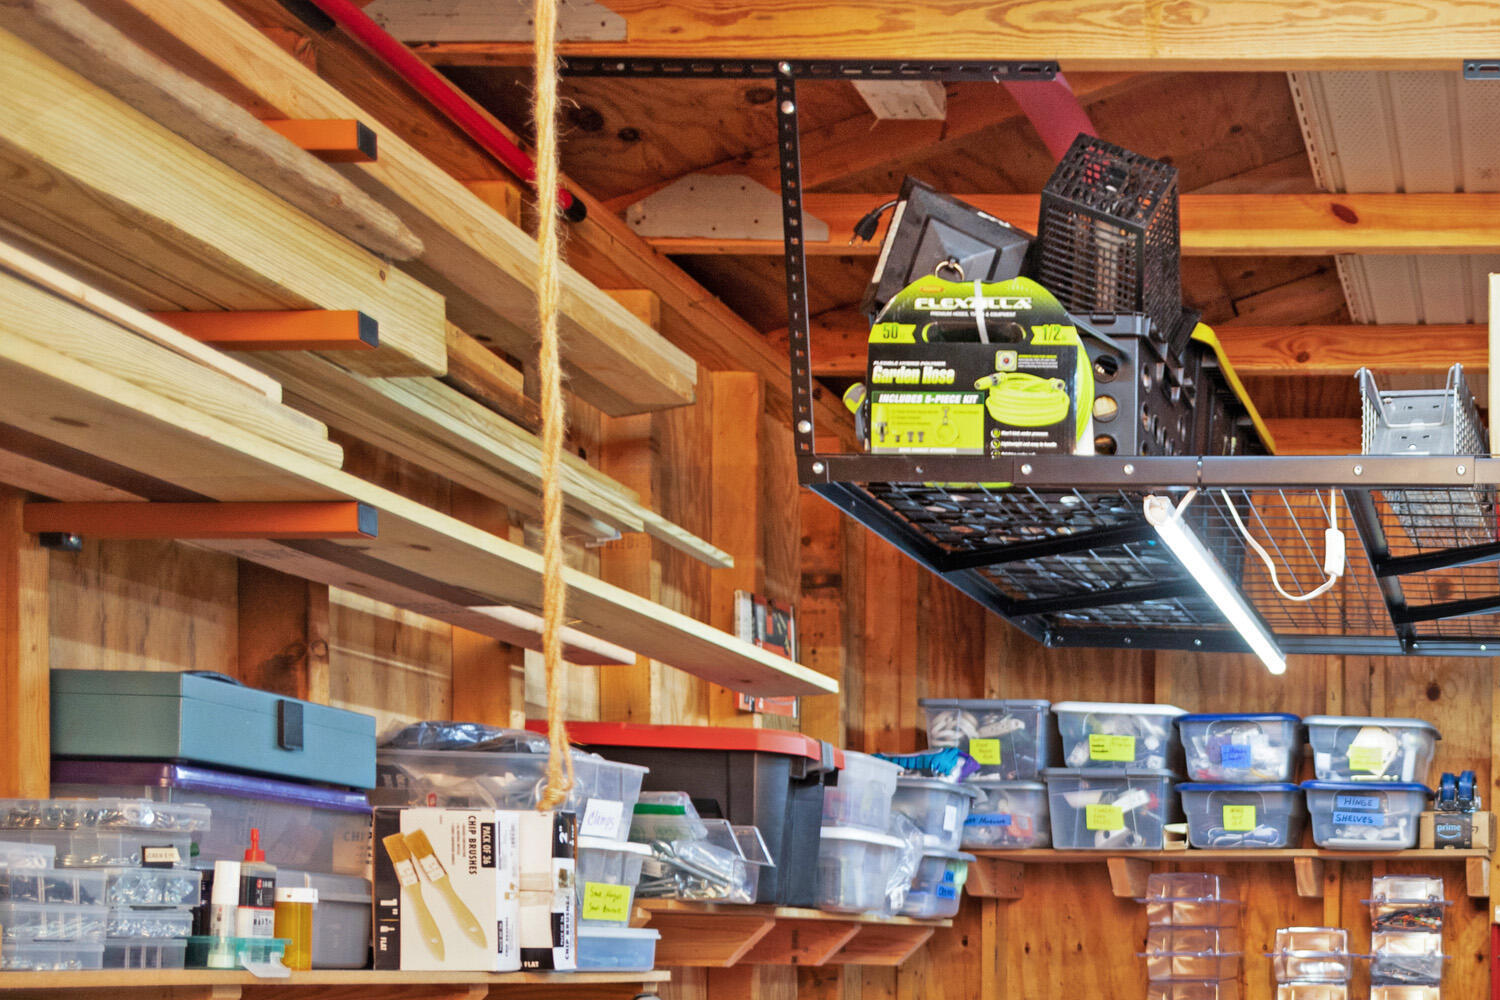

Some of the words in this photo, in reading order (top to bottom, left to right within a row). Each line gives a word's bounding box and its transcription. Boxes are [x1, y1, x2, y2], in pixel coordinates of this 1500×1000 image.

[883, 324, 898, 339] 50
[1043, 325, 1060, 341] 1/2
[872, 365, 920, 384] Garden
[922, 365, 955, 384] Hose
[879, 394, 922, 404] INCLUDES
[962, 394, 979, 404] KIT
[1344, 798, 1373, 807] HINGE
[468, 815, 476, 835] CHIP
[1437, 823, 1461, 832] prime
[483, 825, 491, 843] PACK
[483, 844, 491, 853] OF
[468, 838, 477, 875] BRUSHES
